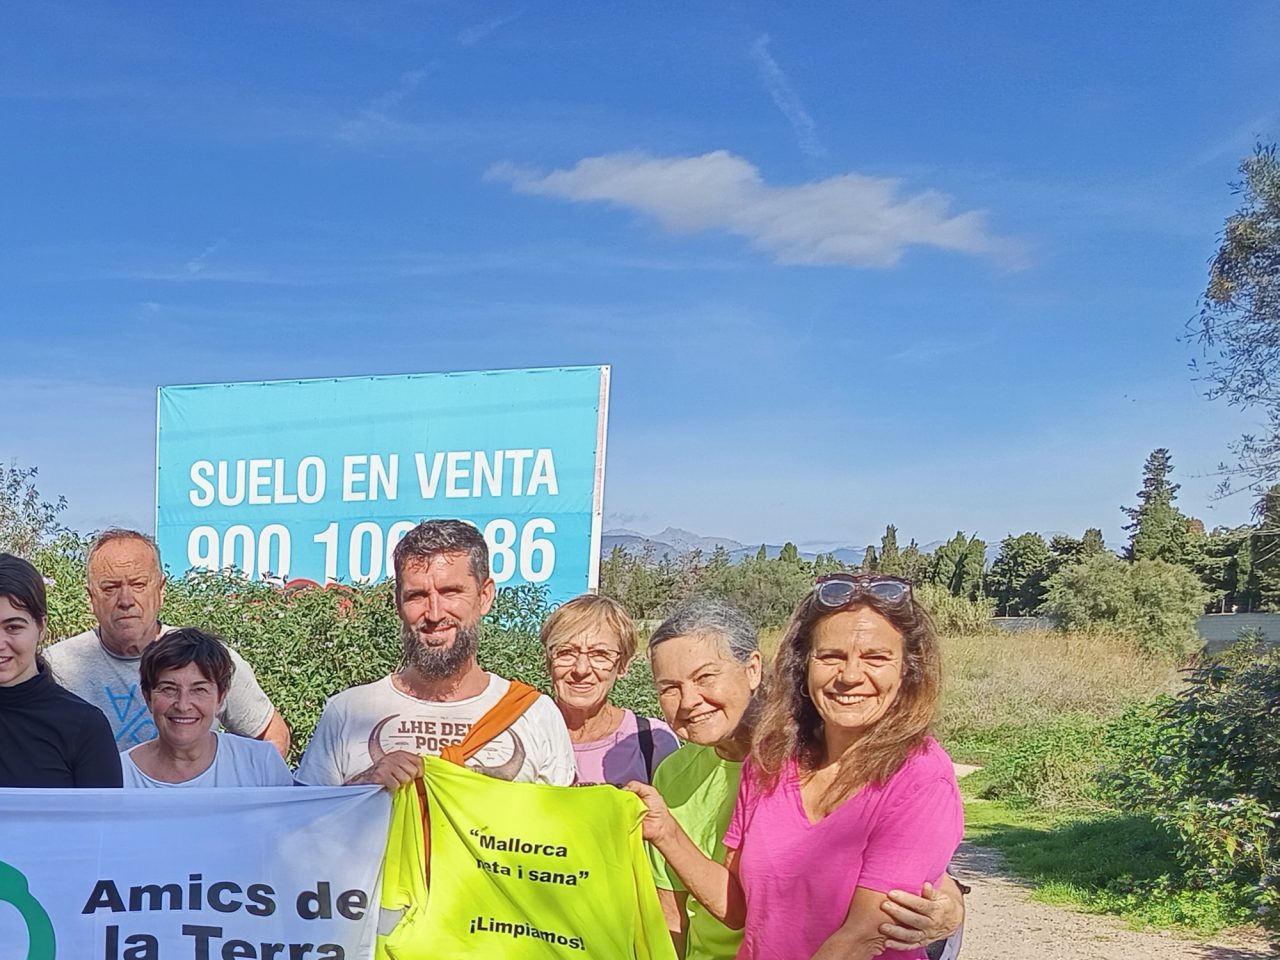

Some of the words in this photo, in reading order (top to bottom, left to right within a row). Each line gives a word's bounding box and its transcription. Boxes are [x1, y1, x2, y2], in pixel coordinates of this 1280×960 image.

[188, 455, 327, 508] SUELO
[342, 453, 400, 503] EN
[414, 447, 560, 499] VENTA
[187, 524, 291, 590] 900
[81, 873, 277, 917] Amics
[296, 880, 369, 921] de
[518, 865, 523, 879] i
